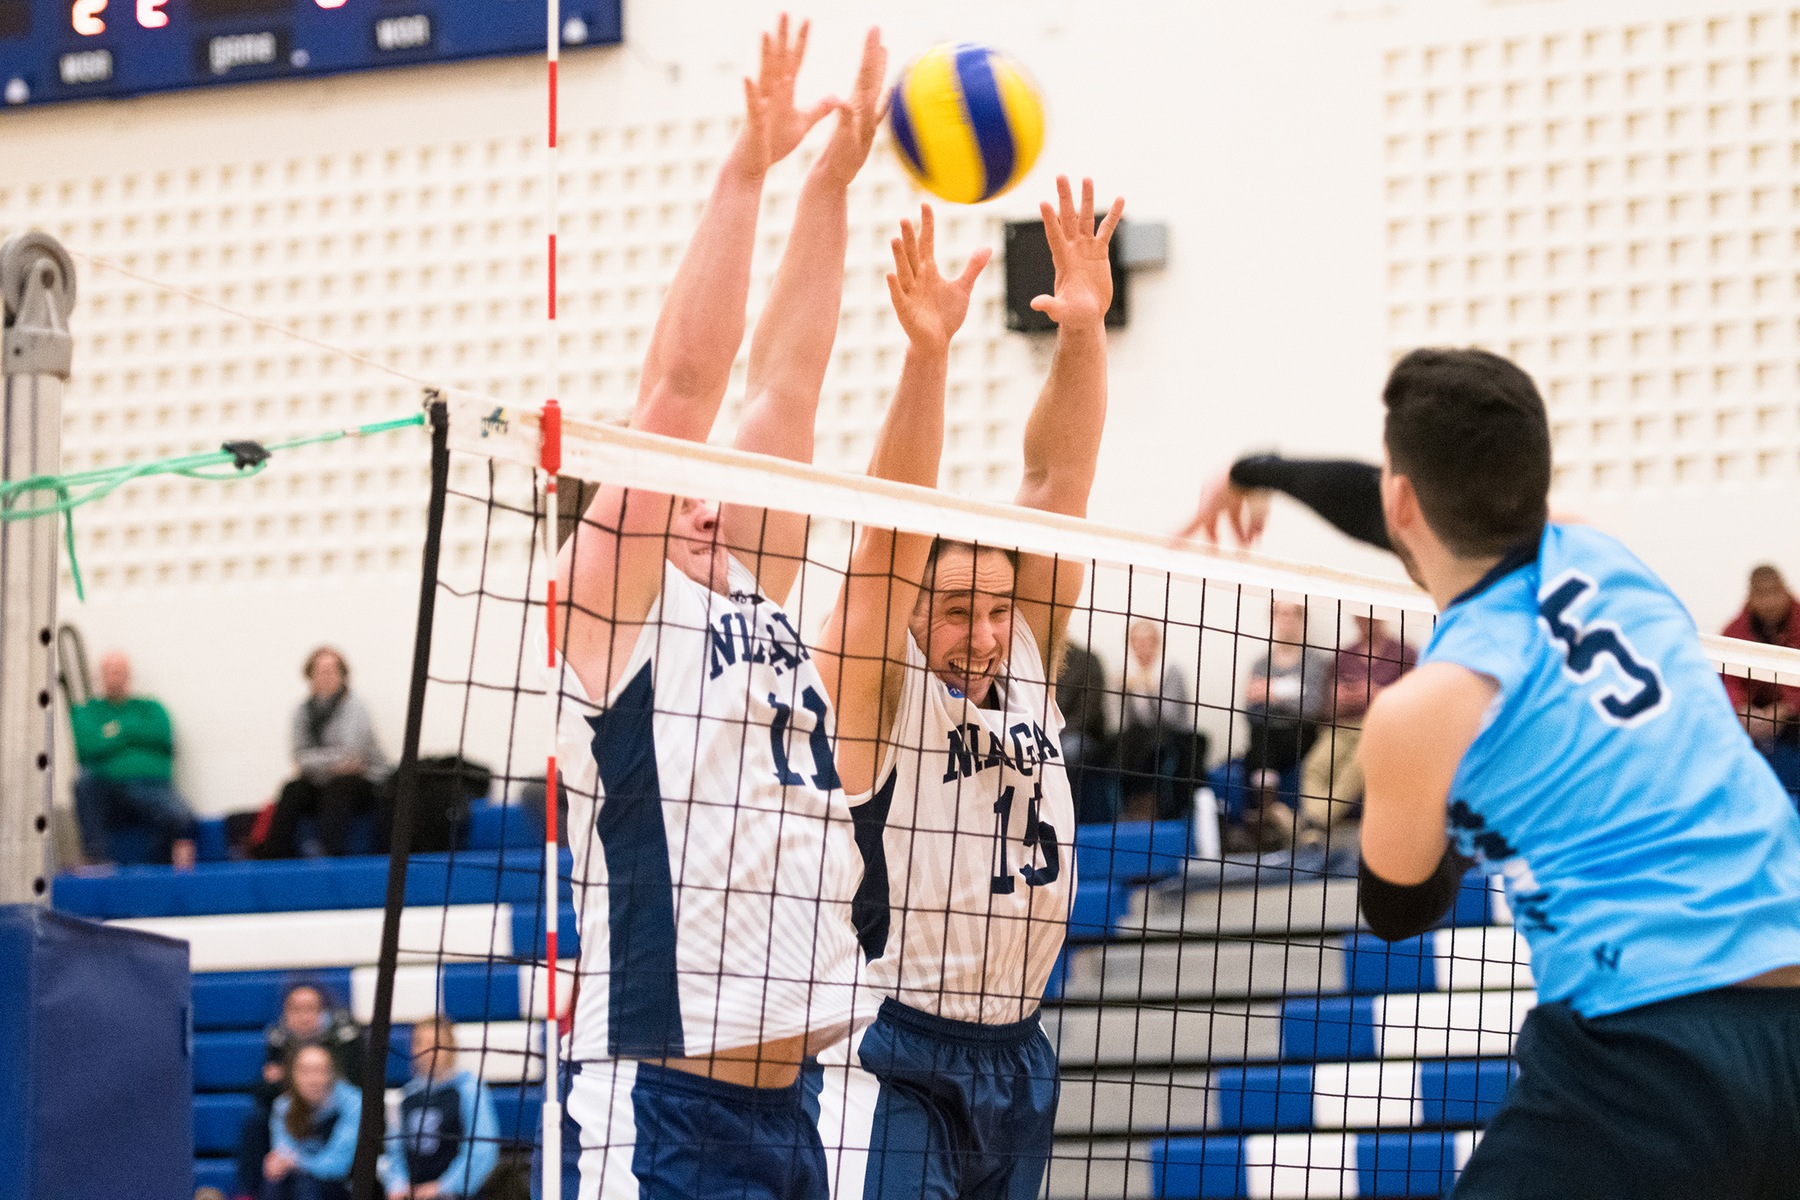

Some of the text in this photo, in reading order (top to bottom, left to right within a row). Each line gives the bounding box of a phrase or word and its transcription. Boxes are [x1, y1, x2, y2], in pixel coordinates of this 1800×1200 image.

[1538, 571, 1669, 726] 5
[767, 685, 842, 791] 11
[991, 782, 1060, 895] 15
